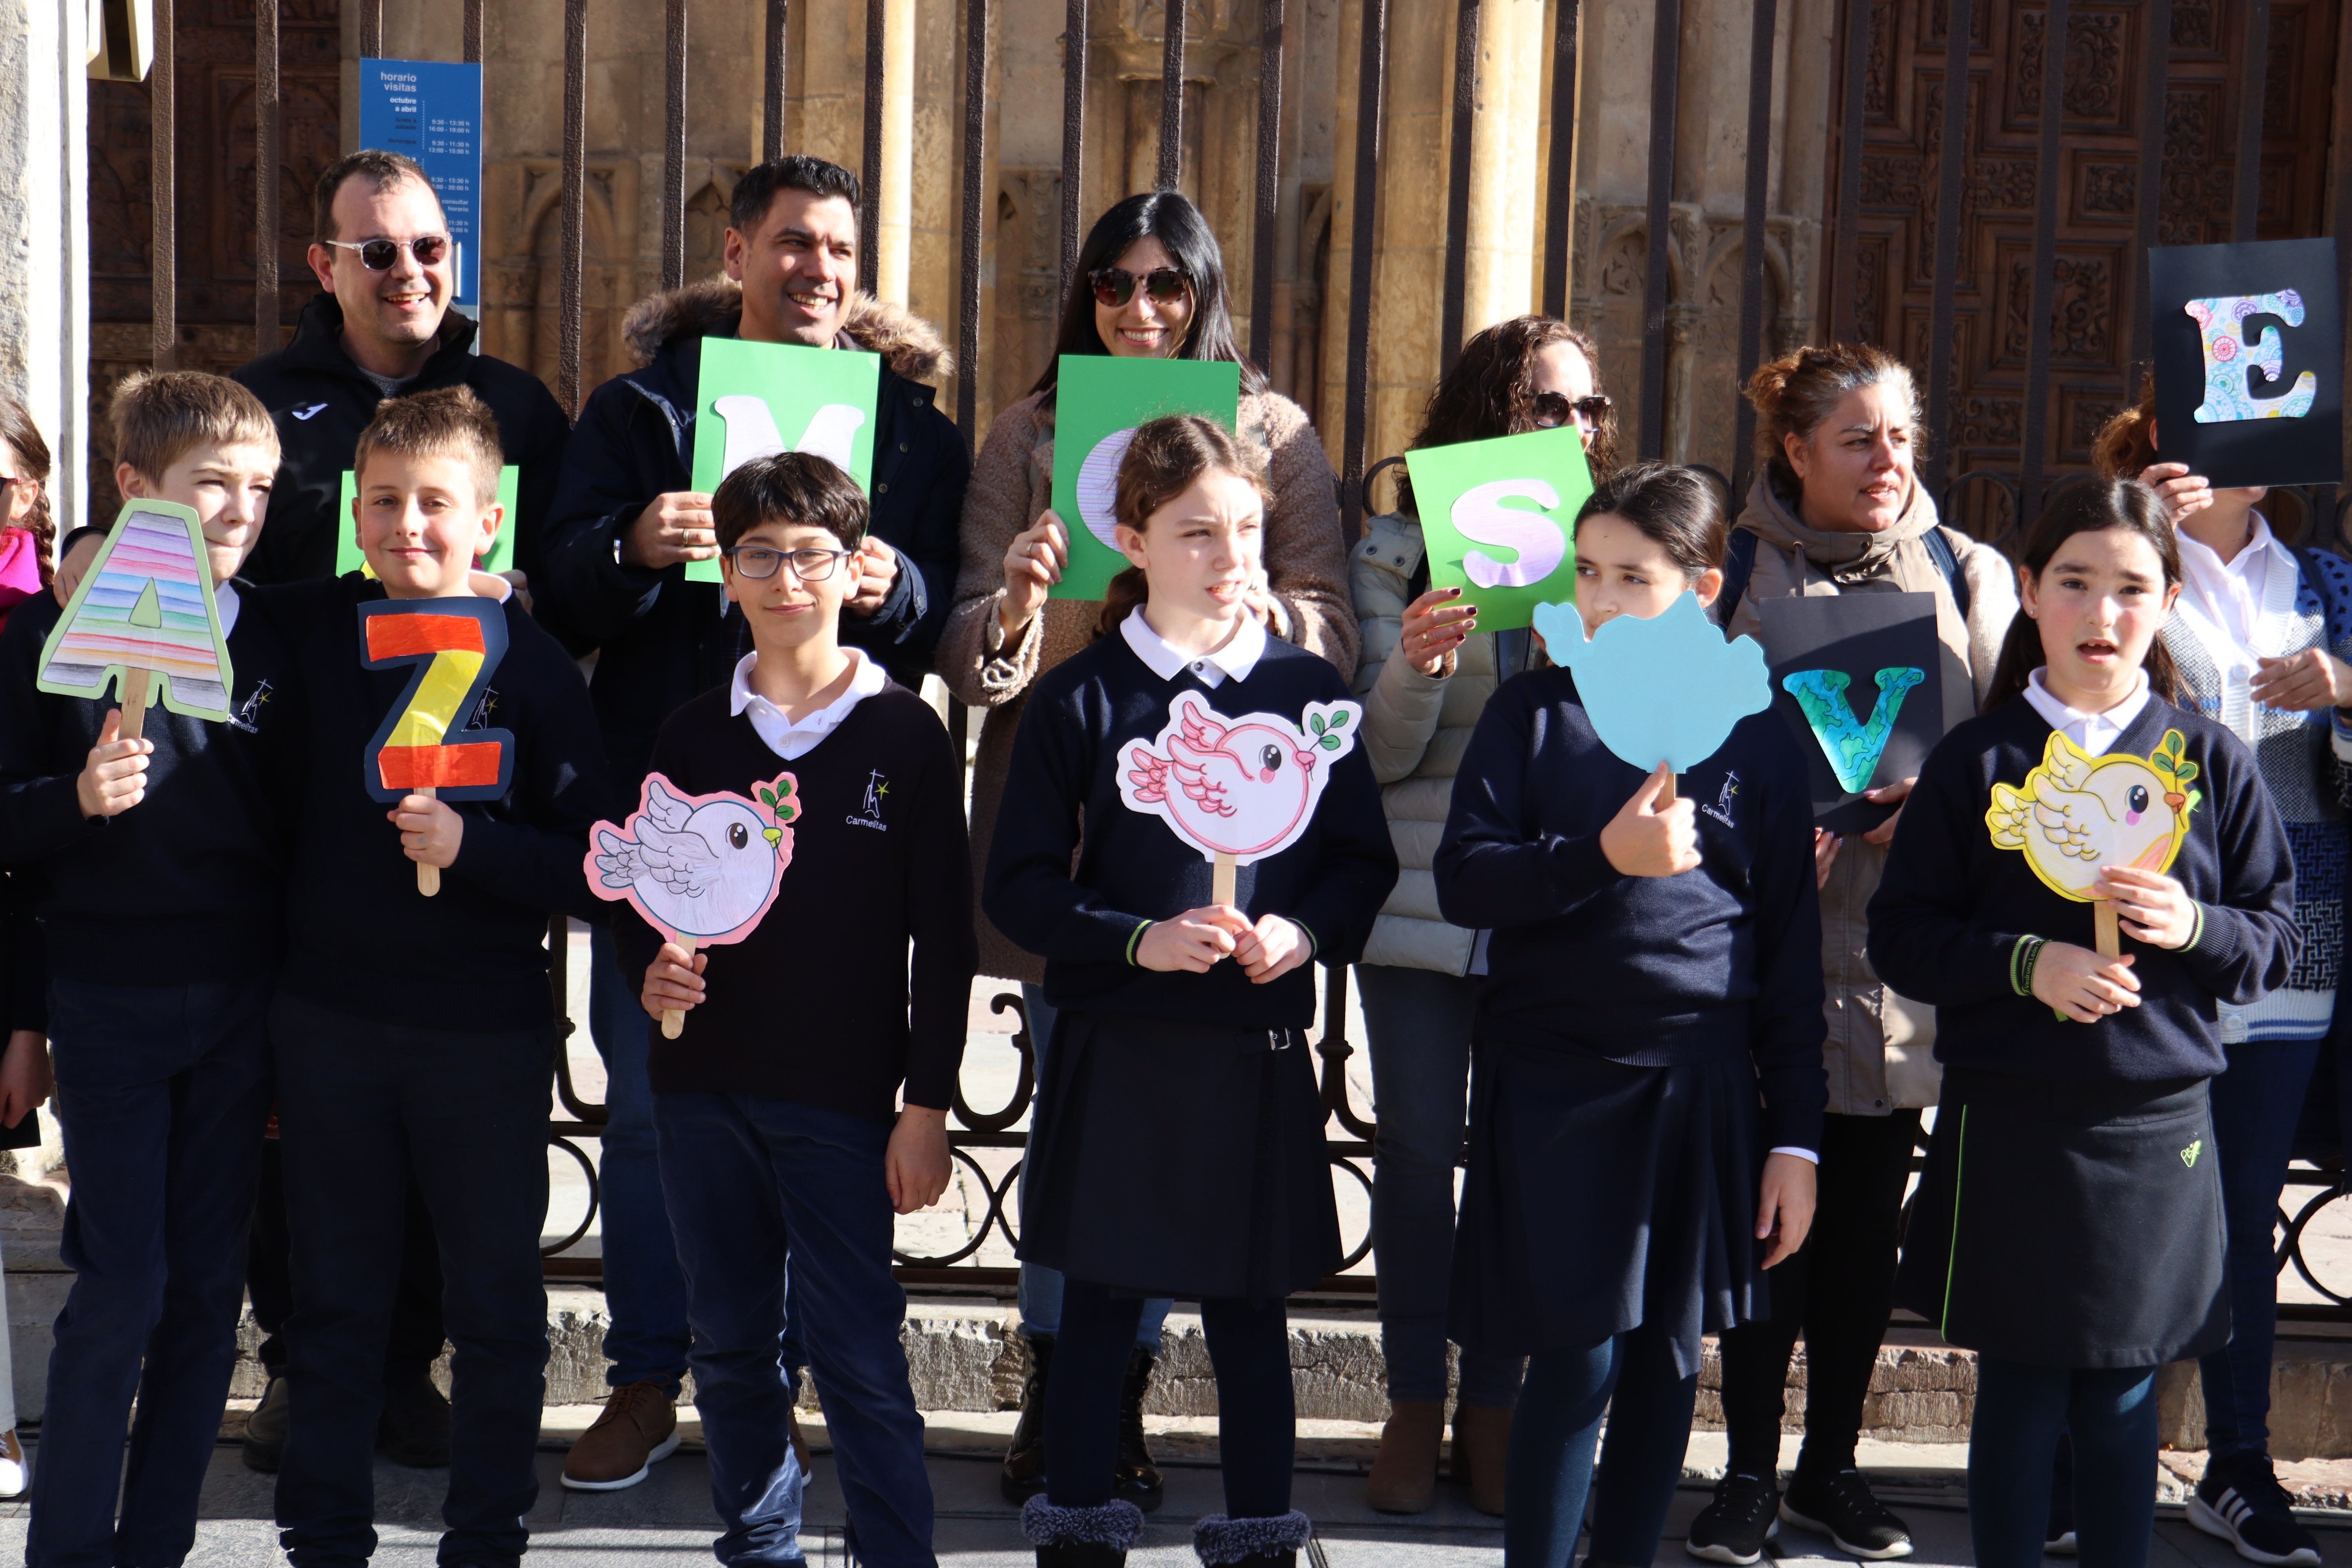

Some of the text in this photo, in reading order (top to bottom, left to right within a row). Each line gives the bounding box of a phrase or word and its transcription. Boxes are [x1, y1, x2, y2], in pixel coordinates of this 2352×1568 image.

[381, 72, 416, 82] horario
[384, 82, 416, 92] visitas
[2185, 289, 2317, 423] E
[1450, 479, 1565, 588] S
[41, 510, 227, 712] A
[366, 613, 501, 789] Z
[227, 714, 258, 733] Carmelitas
[1782, 667, 1924, 794] V
[846, 815, 887, 831] Carmelitas
[1702, 804, 1734, 828] Carmelitas
[2024, 962, 2033, 989] Vedruna
